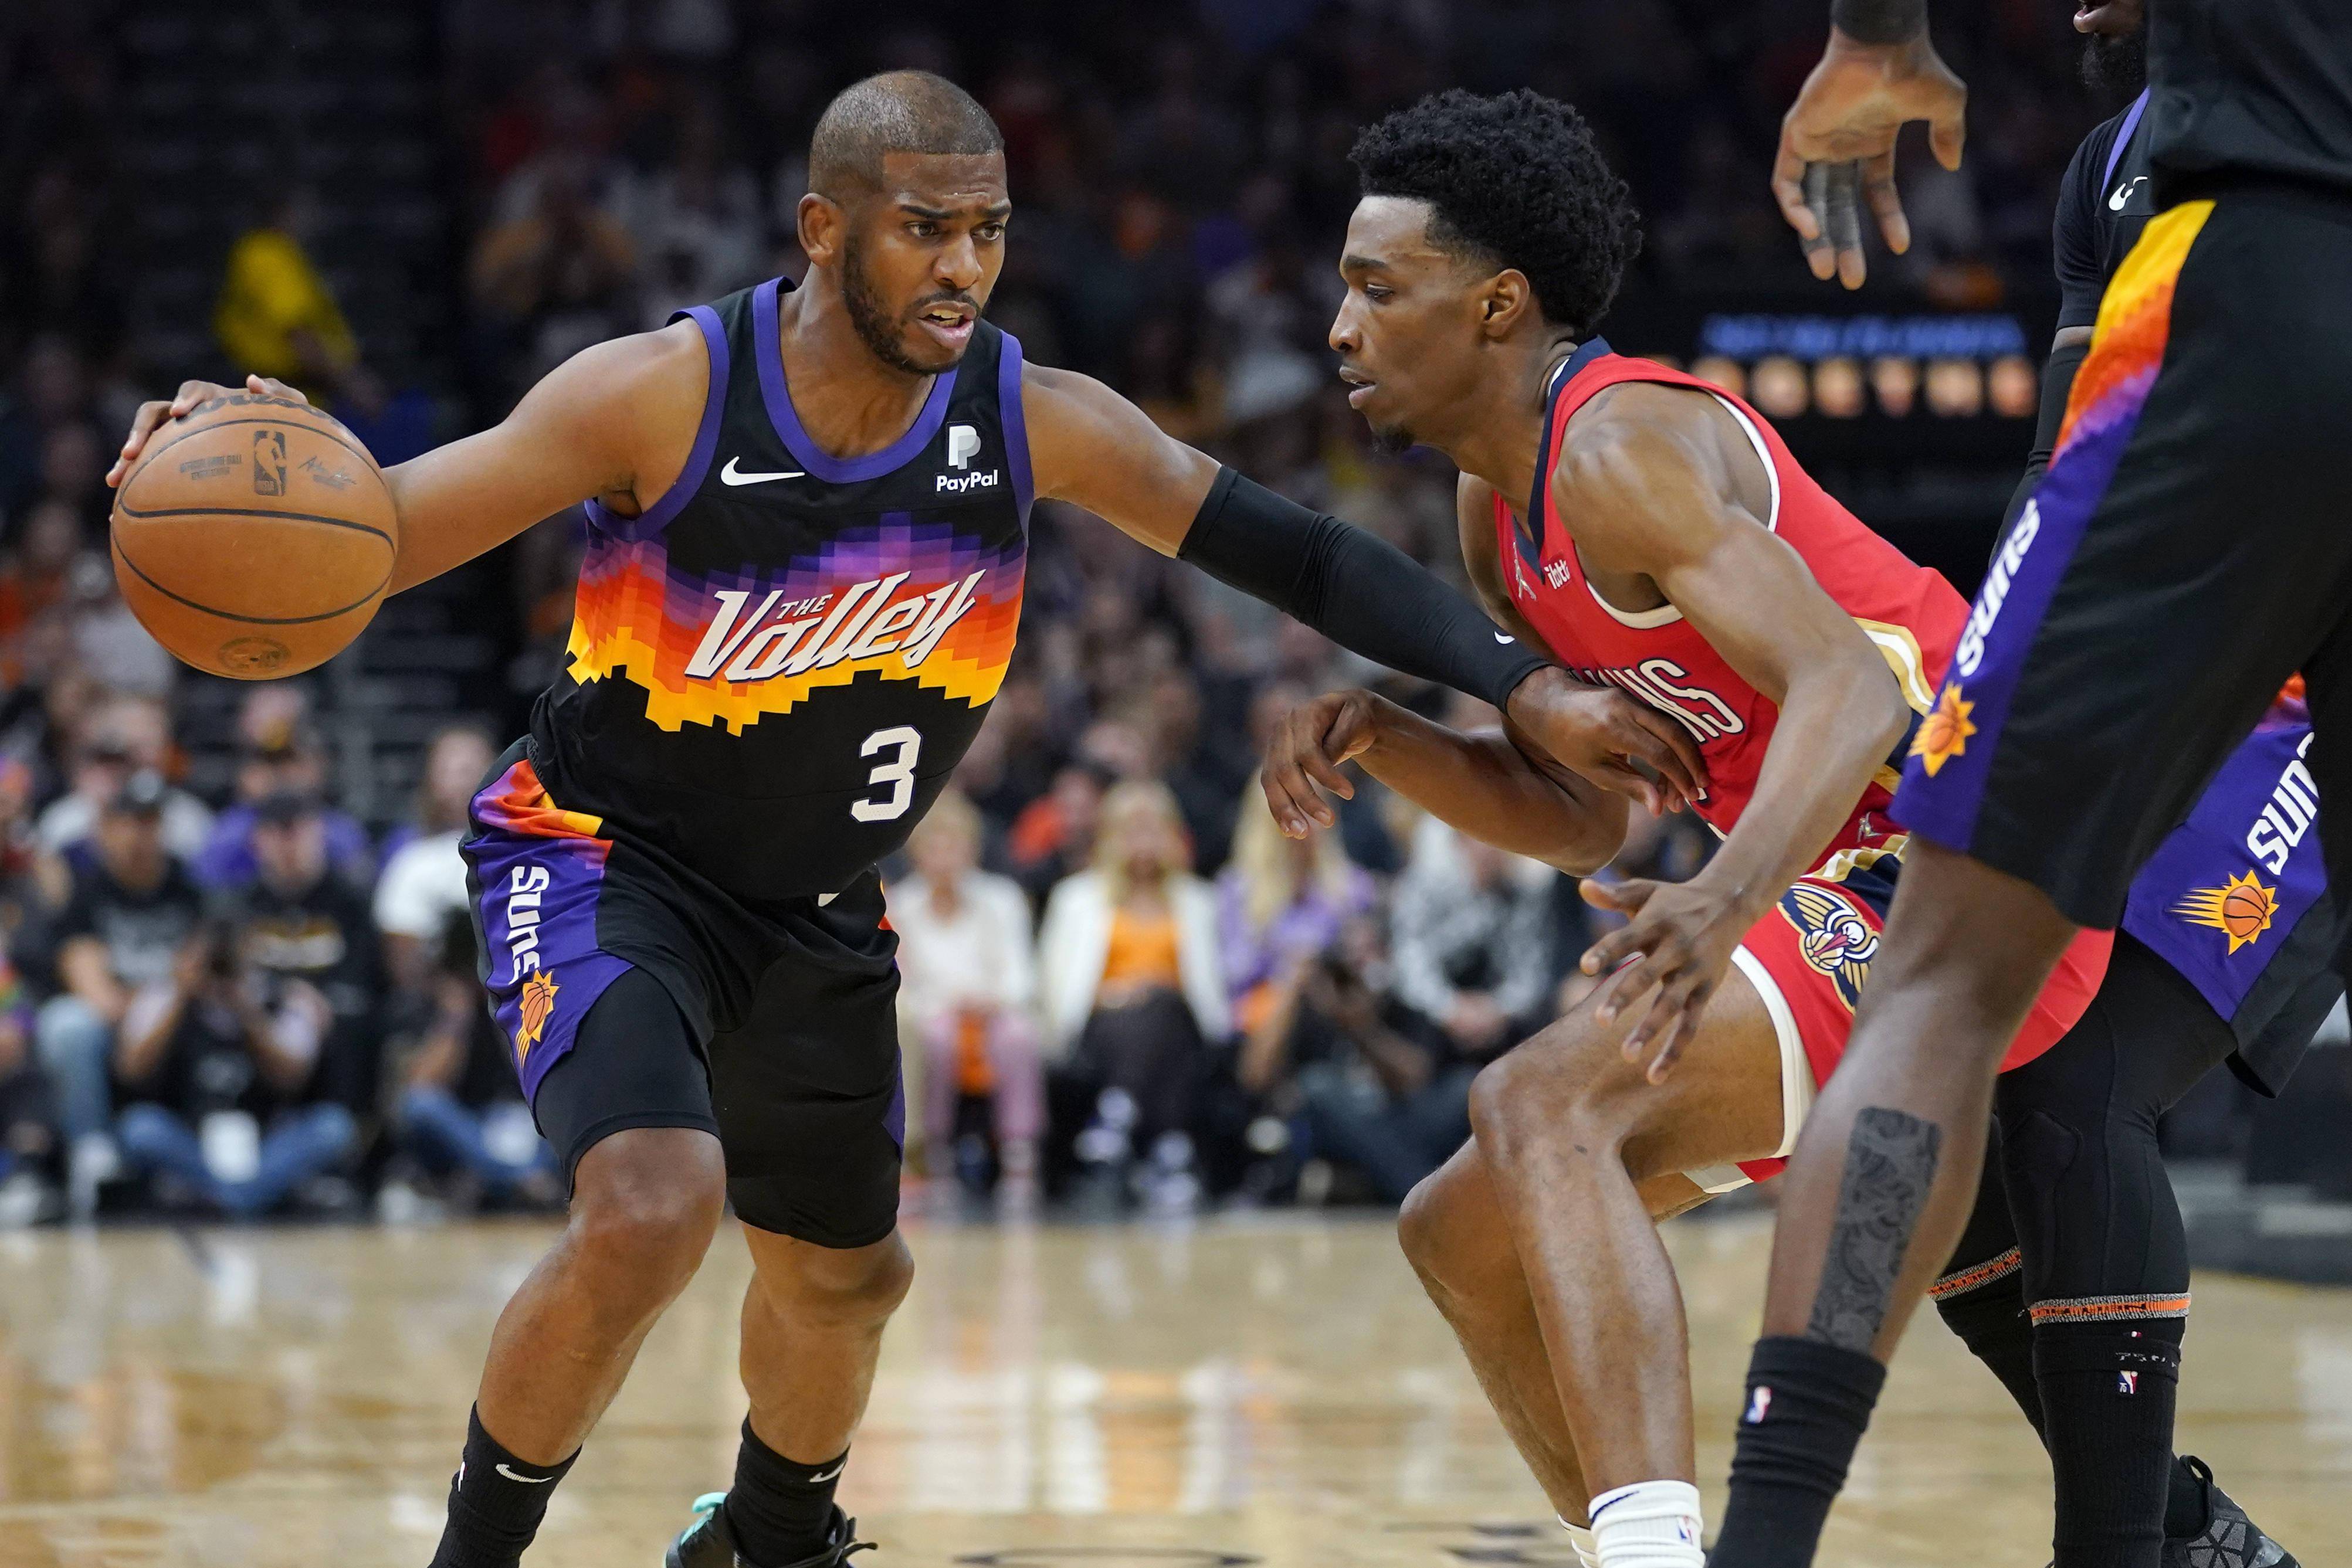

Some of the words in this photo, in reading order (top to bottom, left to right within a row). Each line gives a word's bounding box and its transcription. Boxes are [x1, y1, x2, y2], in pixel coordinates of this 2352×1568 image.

[936, 469, 998, 493] PayPal
[684, 569, 987, 682] Valley
[776, 593, 833, 619] THE
[850, 725, 923, 823] 3
